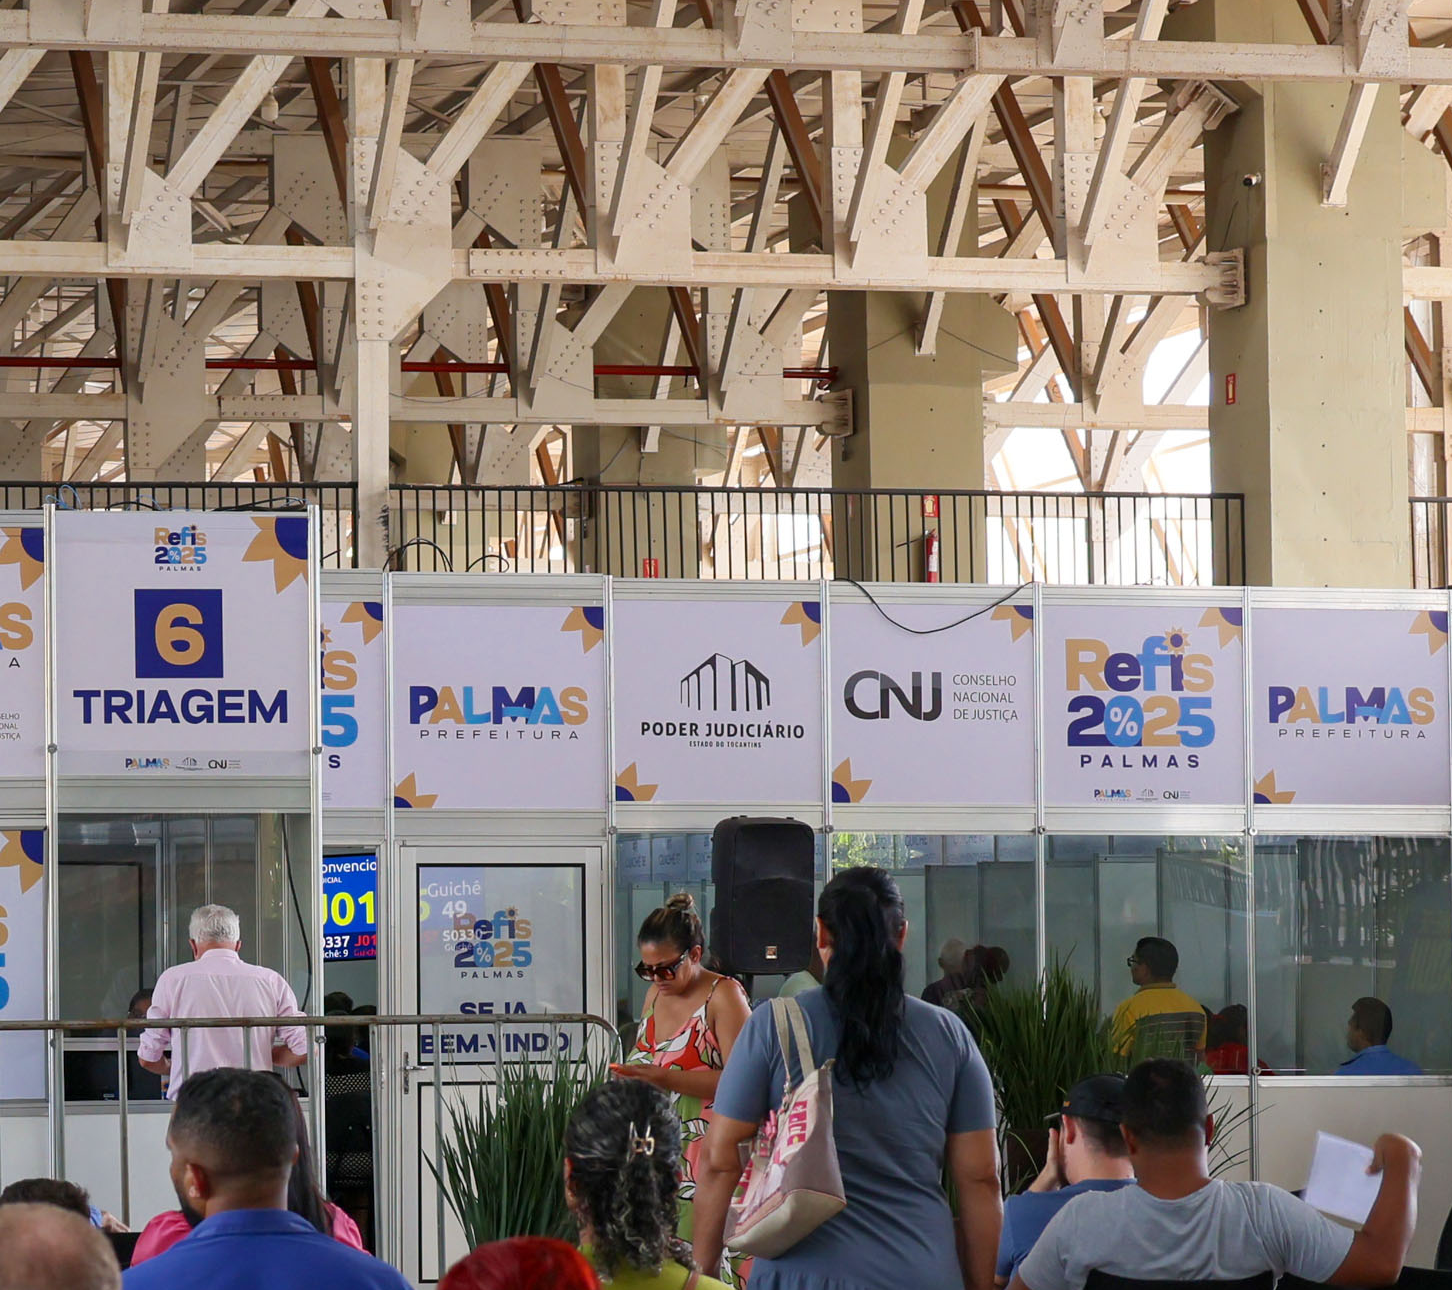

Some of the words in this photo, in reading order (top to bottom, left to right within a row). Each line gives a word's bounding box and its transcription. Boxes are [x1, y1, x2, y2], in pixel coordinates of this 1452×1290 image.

[154, 524, 207, 545] Refis
[155, 603, 205, 665] 6
[1065, 626, 1214, 692] Refis
[953, 674, 1016, 686] CONSELHO
[844, 670, 942, 721] CNJ
[954, 692, 1014, 703] NACIONAL
[73, 689, 287, 724] TRIAGEM
[410, 686, 588, 725] PALMAS
[1269, 686, 1435, 725] PALMAS
[954, 709, 969, 719] DE
[971, 710, 1018, 723] JUSTIÇA
[421, 730, 578, 739] PREFEITURA
[641, 722, 699, 736] PODER
[706, 721, 804, 738] JUDICIÁRIO
[1279, 729, 1425, 739] PREFEITURA
[125, 758, 169, 768] PALMAS
[208, 759, 227, 769] CNJ
[1081, 755, 1199, 768] PALMAS
[1094, 789, 1131, 798] PALMAS
[428, 881, 481, 897] Guichê
[442, 901, 467, 918] 49
[453, 906, 532, 940] Refis
